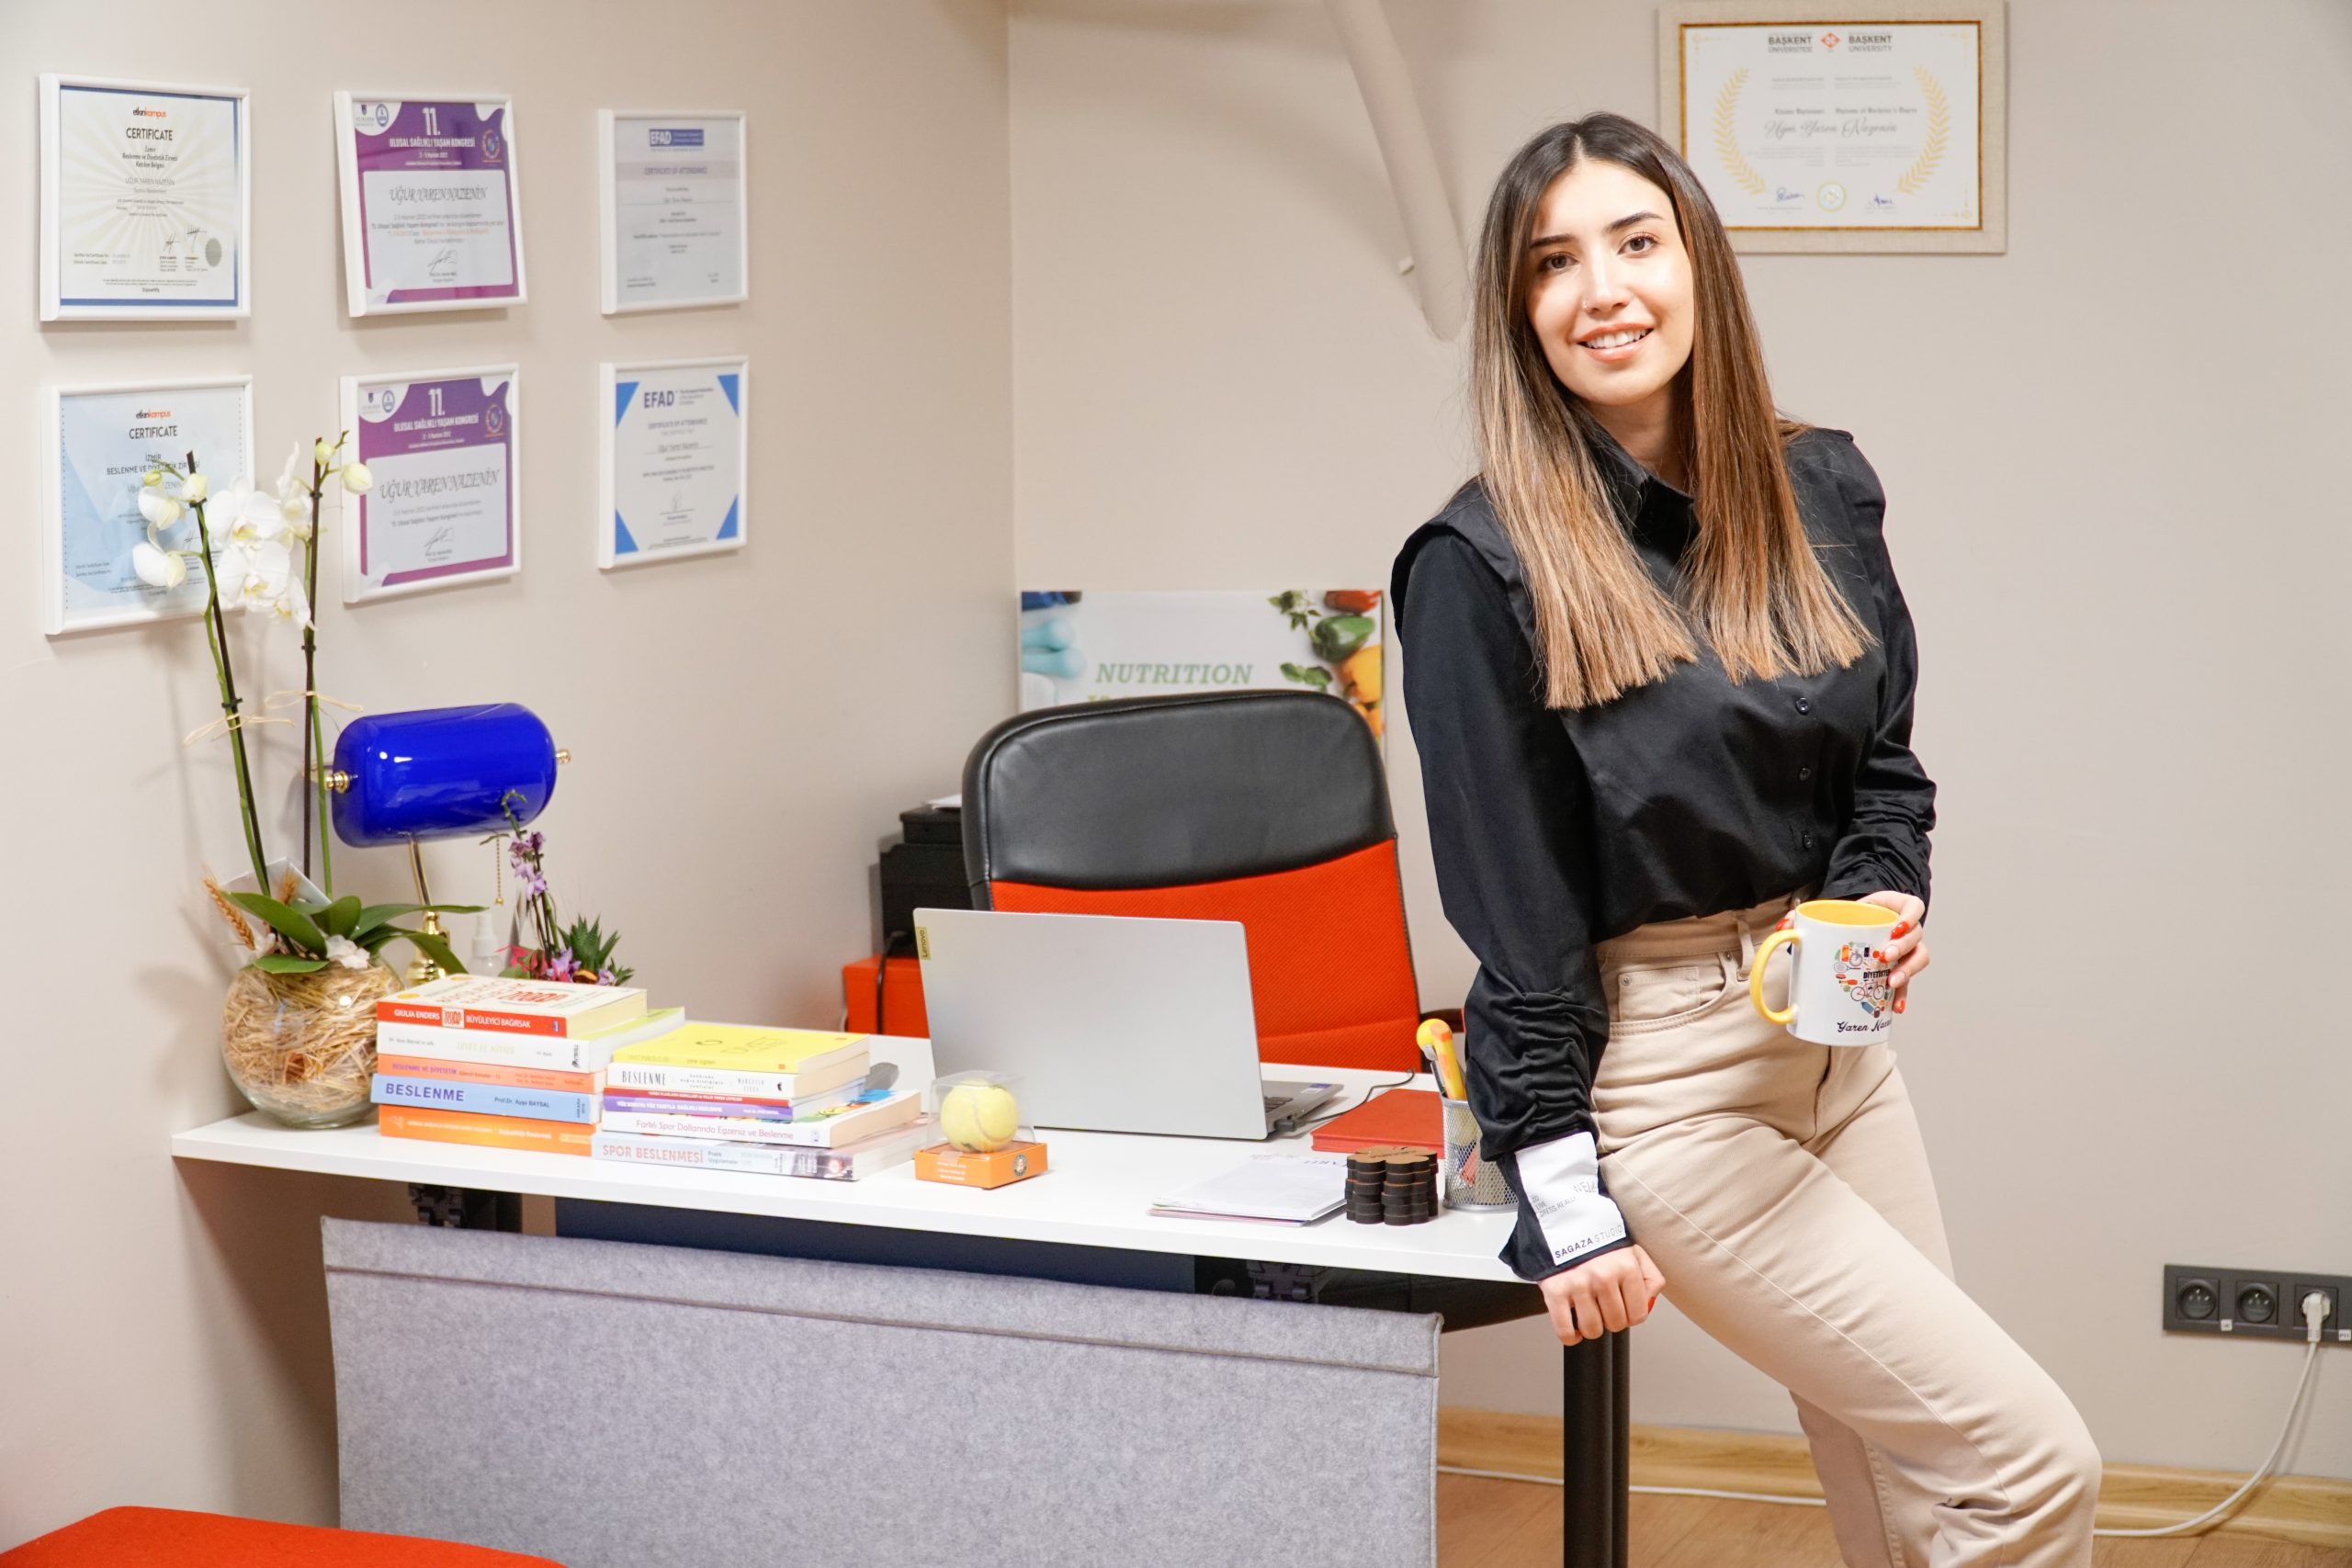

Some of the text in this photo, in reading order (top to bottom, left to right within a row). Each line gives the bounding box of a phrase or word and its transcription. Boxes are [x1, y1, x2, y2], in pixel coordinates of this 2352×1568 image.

[1769, 37, 1812, 46] BAŞKENT
[1849, 36, 1893, 45] BAŞKENT
[423, 107, 441, 136] 11.
[127, 128, 173, 141] CERTIFICATE
[650, 131, 672, 145] EFAD
[429, 389, 445, 416] 11.
[644, 390, 674, 408] EFAD
[130, 426, 177, 439] CERTIFICATE
[107, 466, 138, 475] BESLENME
[1095, 663, 1253, 685] NUTRITION
[920, 930, 928, 957] Lenovo
[394, 1009, 441, 1020] GIULIA ENDERS
[466, 1014, 531, 1029] BÜYÜLEYİCİ BAĞIRSAK
[1838, 1021, 1868, 1032] Yaren
[622, 1071, 665, 1086] BESLENME
[386, 1083, 465, 1102] BESLENME
[637, 1120, 656, 1128] Farklı
[660, 1122, 675, 1131] Spor
[759, 1129, 794, 1139] Beslenme
[603, 1145, 704, 1164] SPOR BESLENMESİ
[1555, 1224, 1623, 1258] SAGAZA STUDIO
